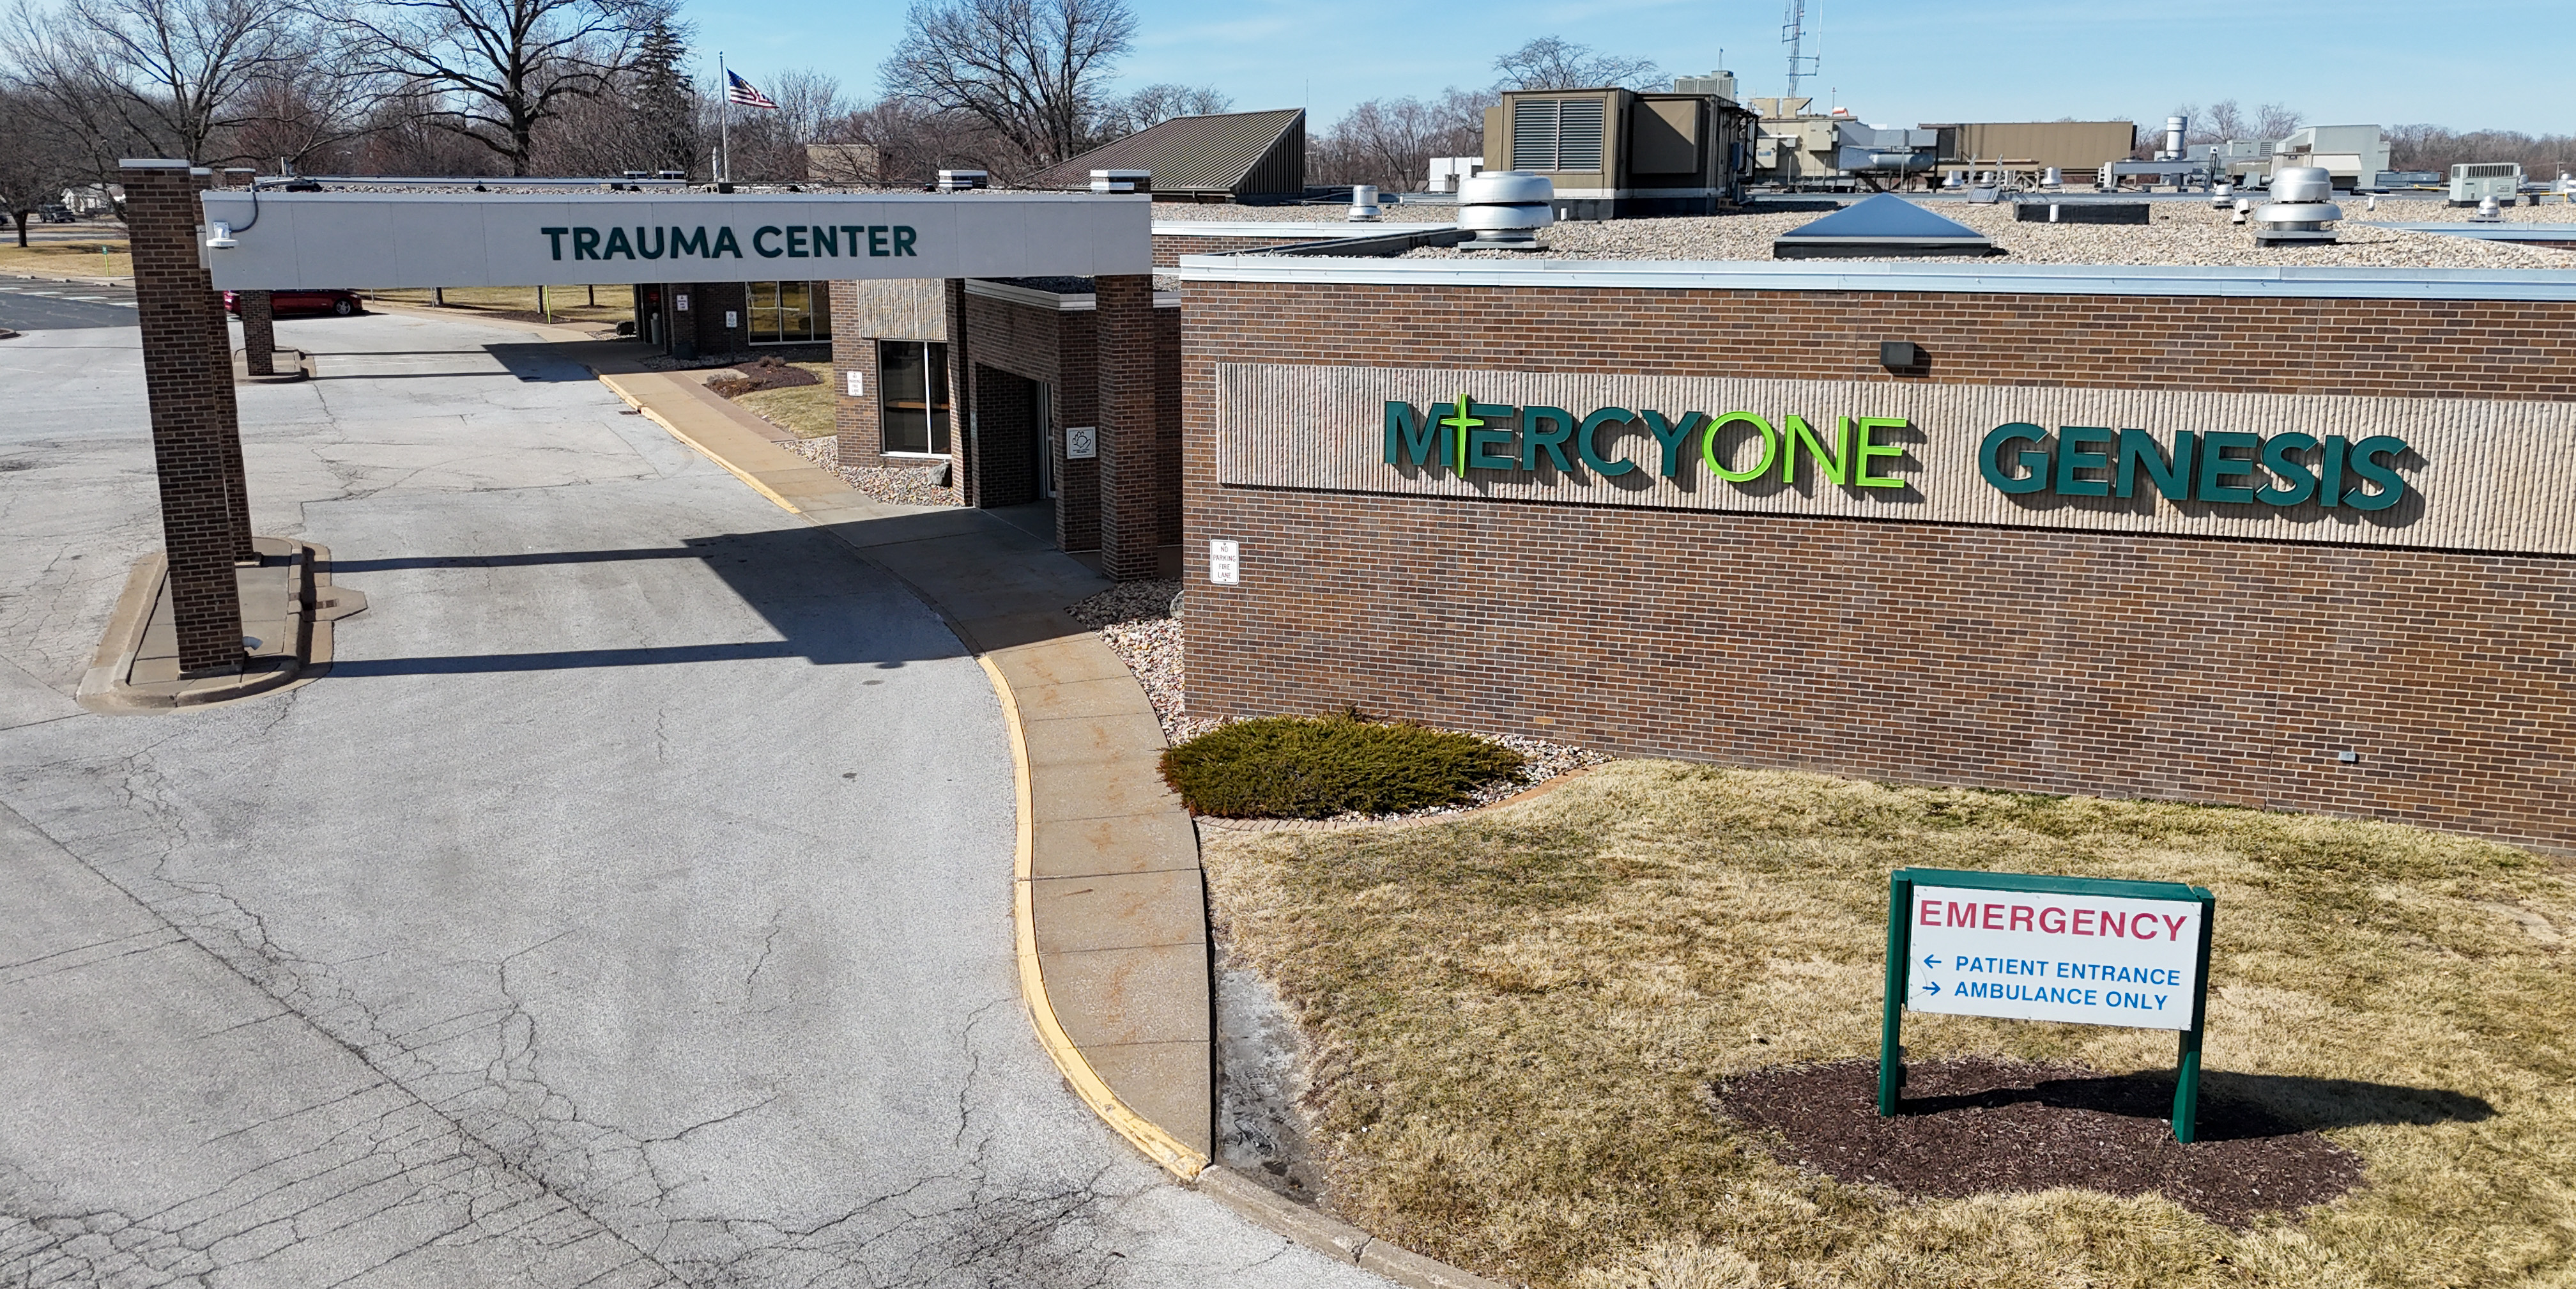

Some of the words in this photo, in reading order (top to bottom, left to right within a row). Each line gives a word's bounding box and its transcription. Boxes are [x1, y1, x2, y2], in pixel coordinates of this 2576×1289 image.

[540, 226, 744, 261] TRAUMA
[753, 225, 917, 258] CENTER
[1978, 422, 2409, 511] GENESIS
[1213, 554, 1236, 562] PARKING
[1920, 899, 2188, 942] EMERGENCY
[1956, 955, 2050, 976] PATIENT
[2057, 962, 2181, 986] ENTRANCE
[1954, 981, 2097, 1006] AMBULANCE
[2106, 991, 2168, 1010] ONLY
